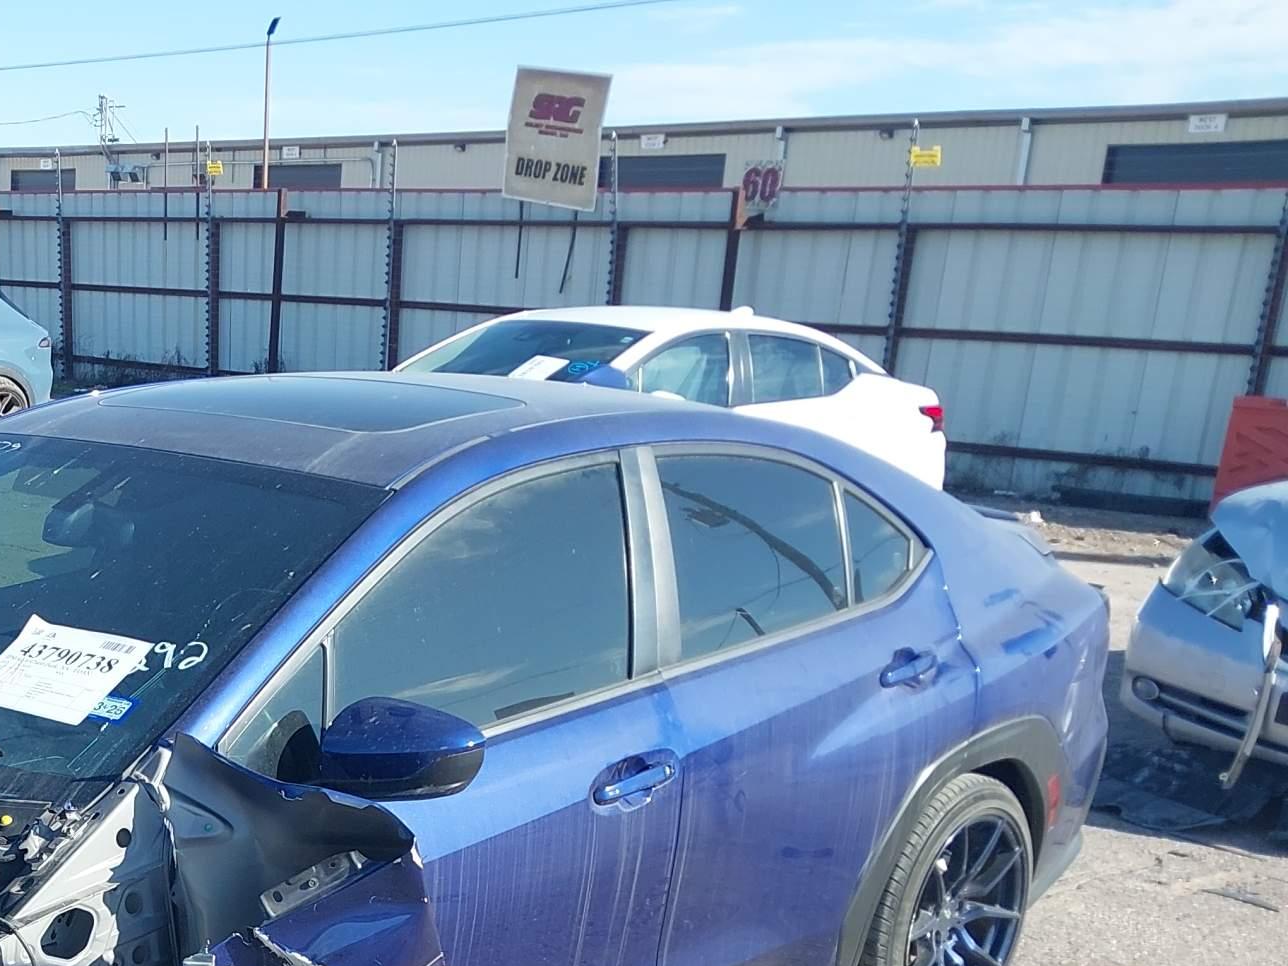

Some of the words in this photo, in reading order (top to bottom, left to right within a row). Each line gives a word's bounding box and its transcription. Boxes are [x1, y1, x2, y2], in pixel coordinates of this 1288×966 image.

[515, 157, 552, 180] DROP
[552, 162, 588, 186] ZONE
[742, 167, 780, 203] 60
[20, 643, 120, 673] 43790738
